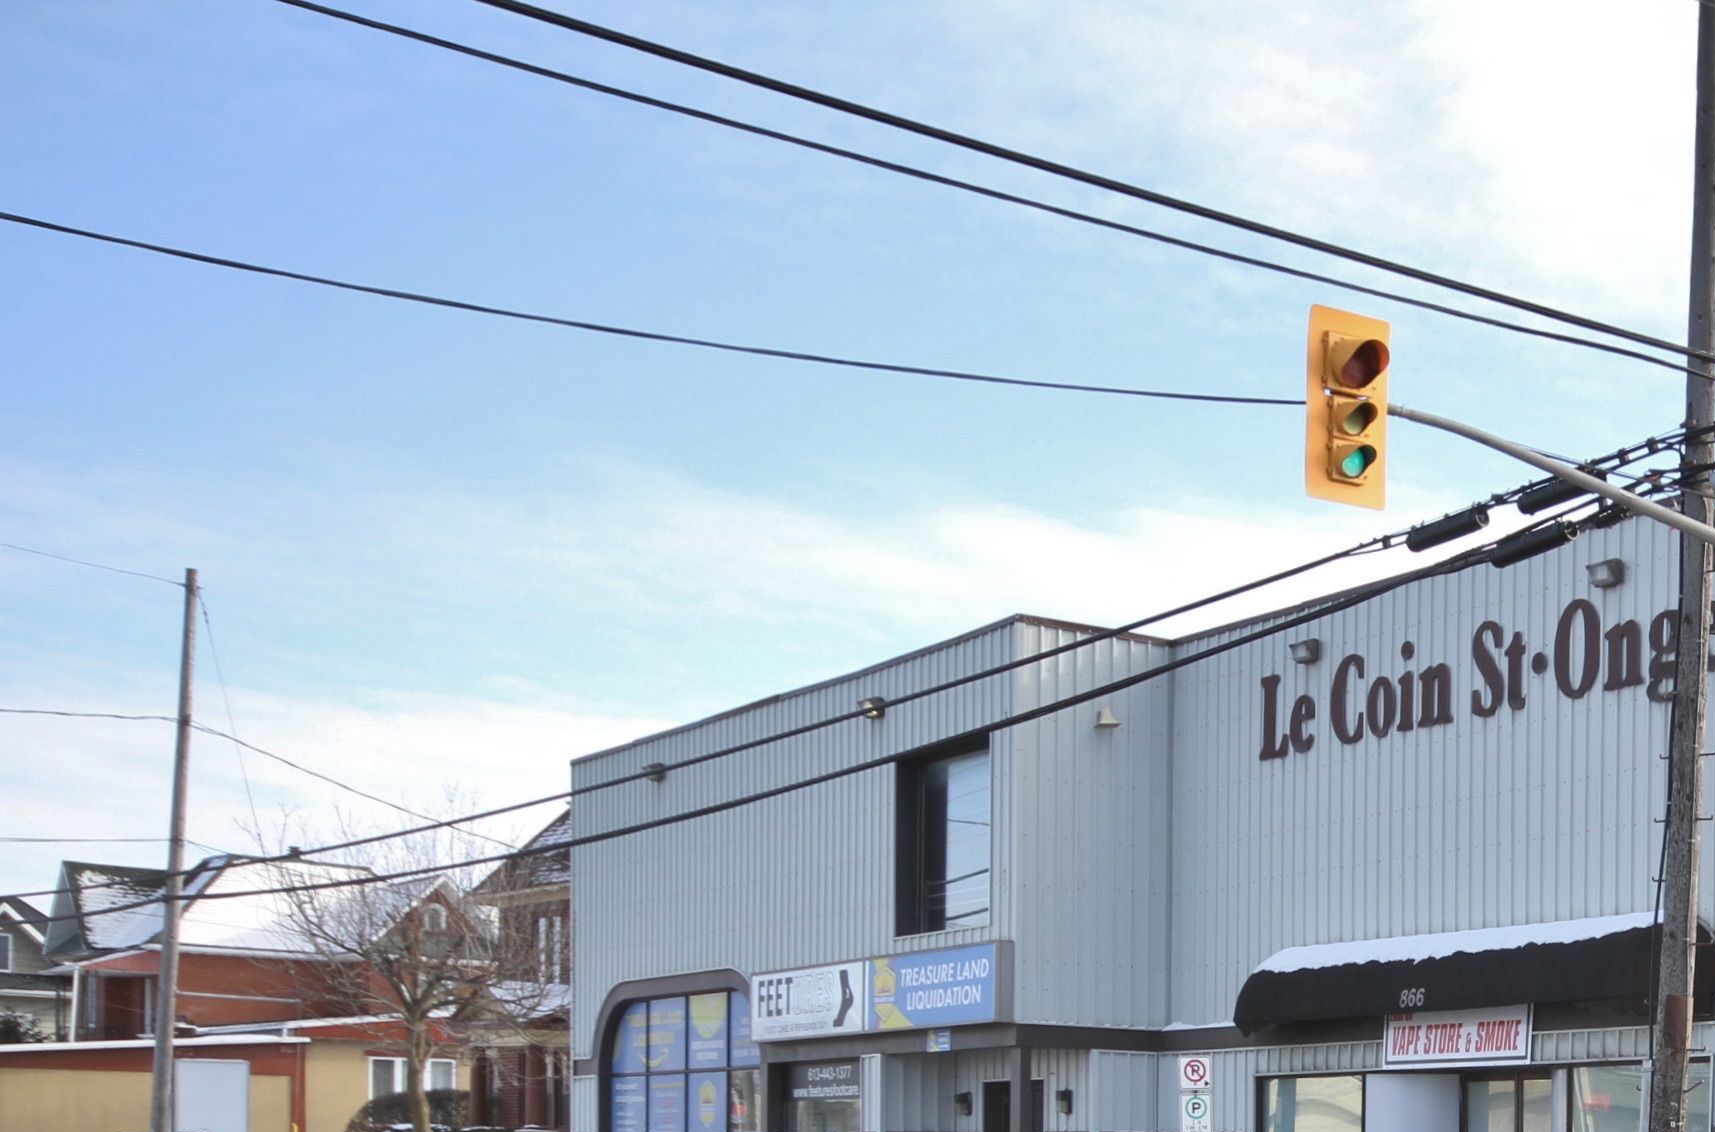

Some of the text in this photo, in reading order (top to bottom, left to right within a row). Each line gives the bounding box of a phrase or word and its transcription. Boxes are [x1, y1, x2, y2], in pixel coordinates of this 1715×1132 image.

[1260, 674, 1316, 760] Le
[1330, 641, 1453, 744] Coin
[900, 958, 989, 988] TREASURE LAND
[906, 984, 982, 1011] LIQUIDATION
[1399, 988, 1425, 1008] 866
[1391, 1019, 1522, 1056] VAPE STORE & SMOKE
